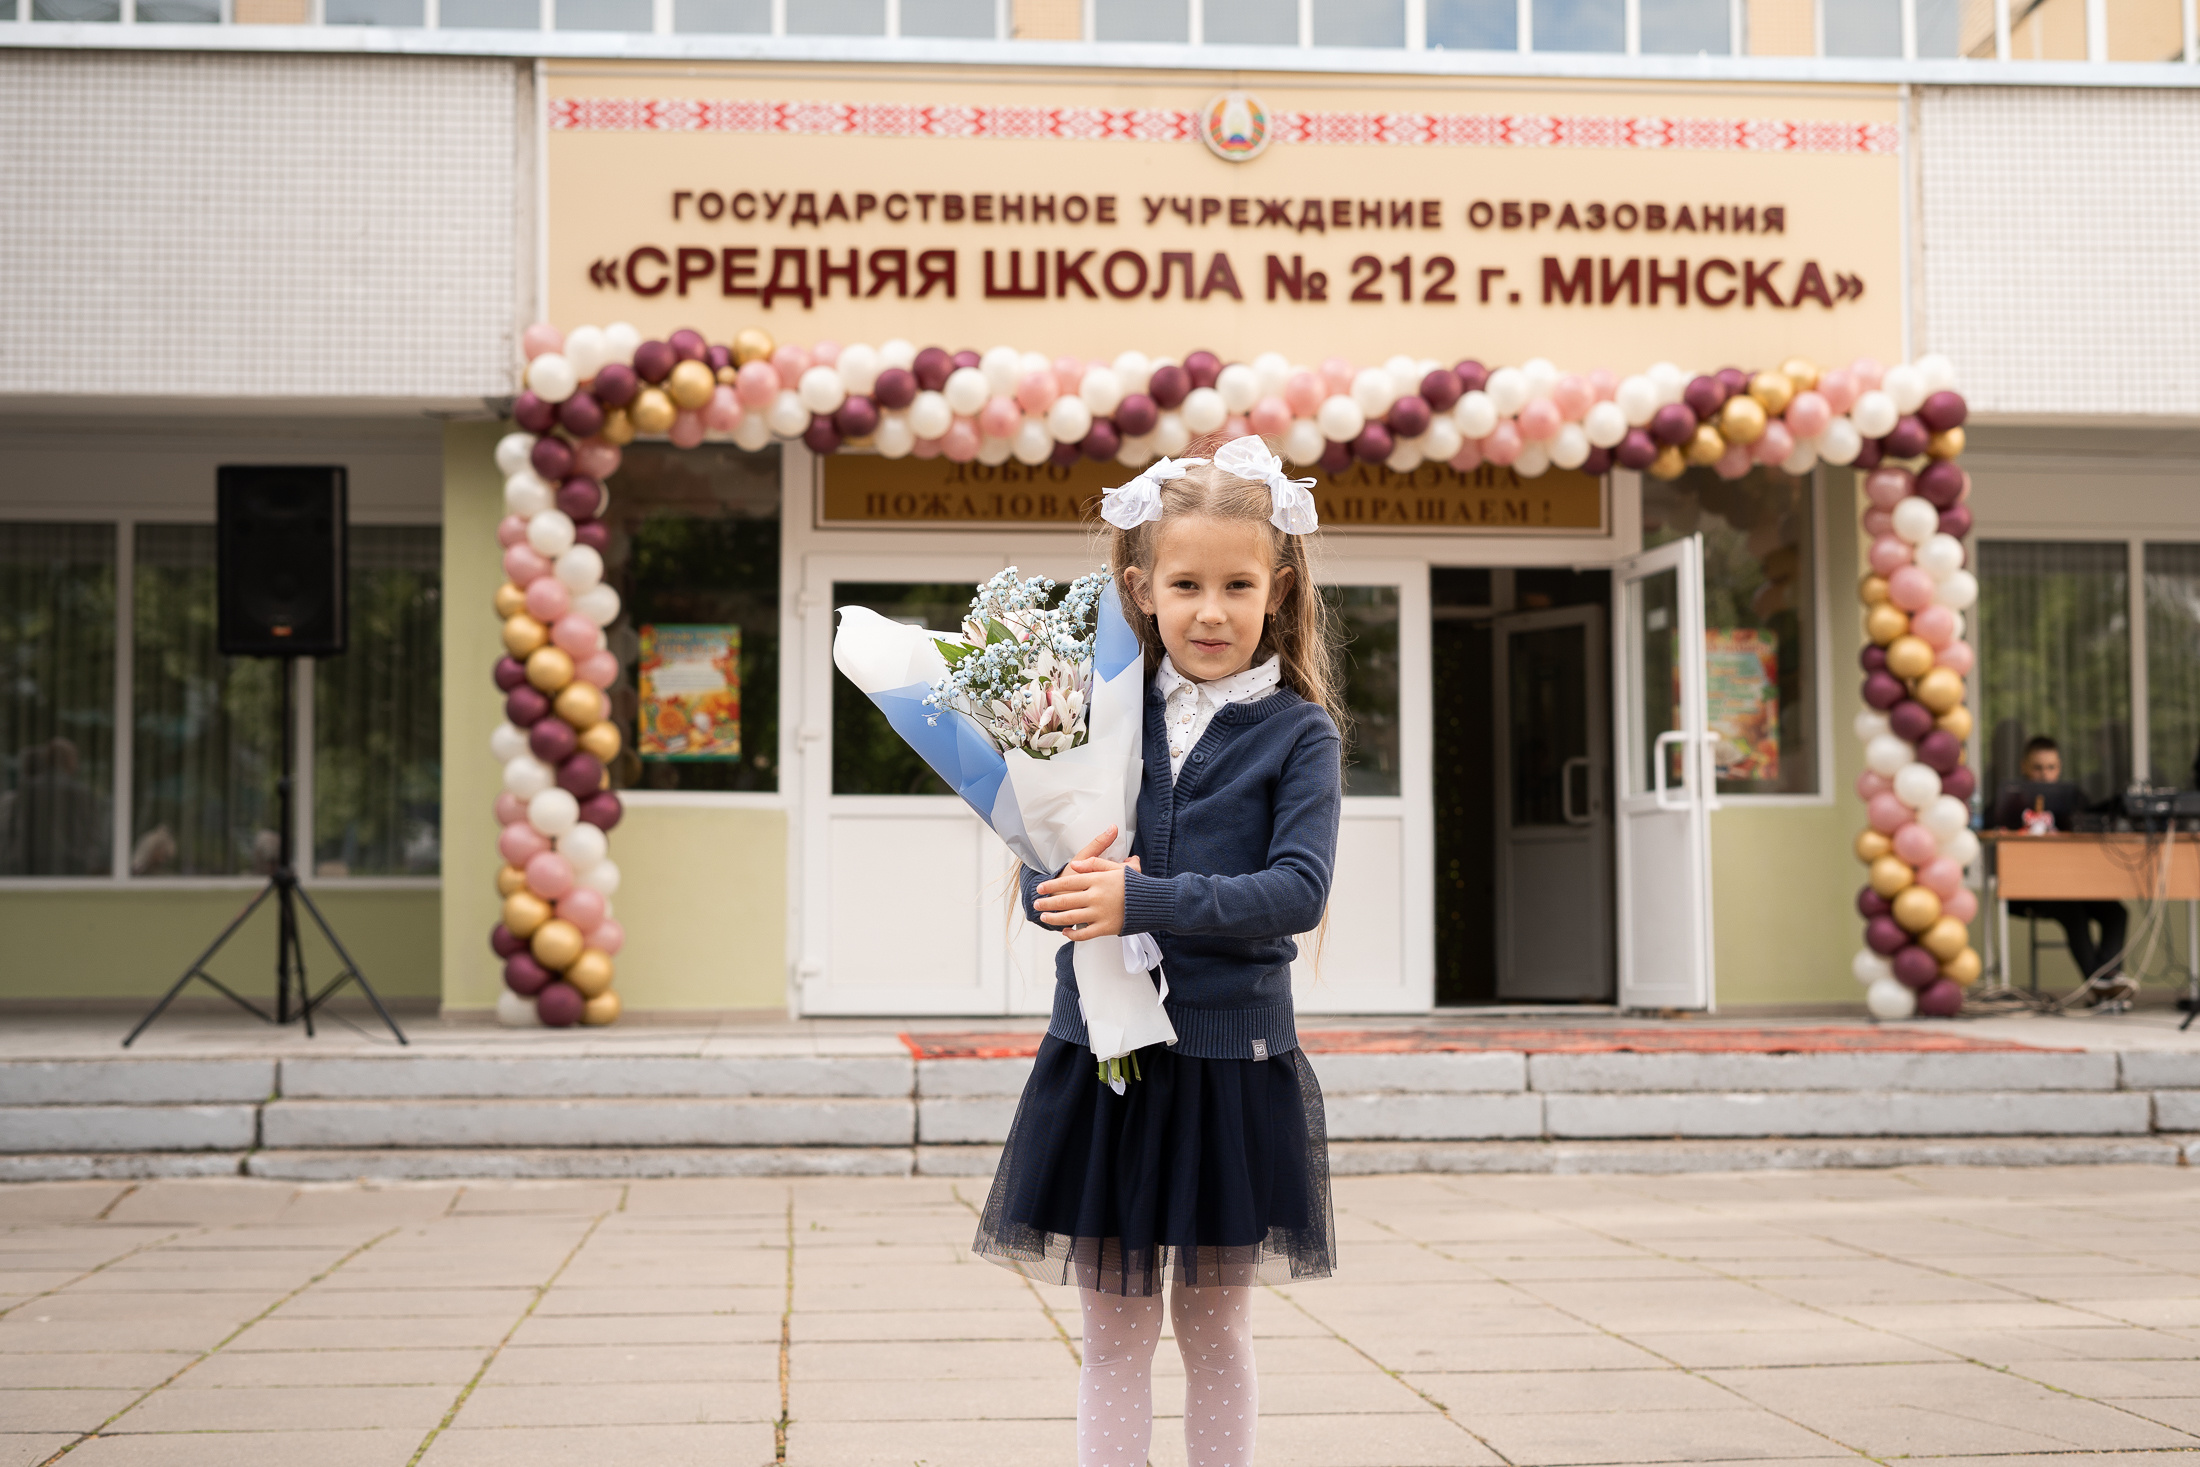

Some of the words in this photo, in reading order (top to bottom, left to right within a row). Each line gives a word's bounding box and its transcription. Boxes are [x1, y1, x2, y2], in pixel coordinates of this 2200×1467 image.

[672, 190, 1119, 227] ГОСУДАРСТВЕННОЕ
[1142, 196, 1442, 233] УЧРЕЖДЕНИЕ
[1467, 200, 1787, 234] ОБРАЗОВАНИЯ
[588, 246, 958, 310] «СРЕДНЯЯ
[983, 250, 1244, 302] ШКОЛА
[1265, 254, 1329, 303] №
[1350, 255, 1457, 303] 212
[1478, 265, 1522, 304] г.
[1541, 256, 1865, 310] МИНСКА»
[944, 462, 1071, 485] ДОБРО
[865, 491, 1099, 519] ПОЖАЛОВА
[1320, 498, 1529, 523] АПРАШАЕМ
